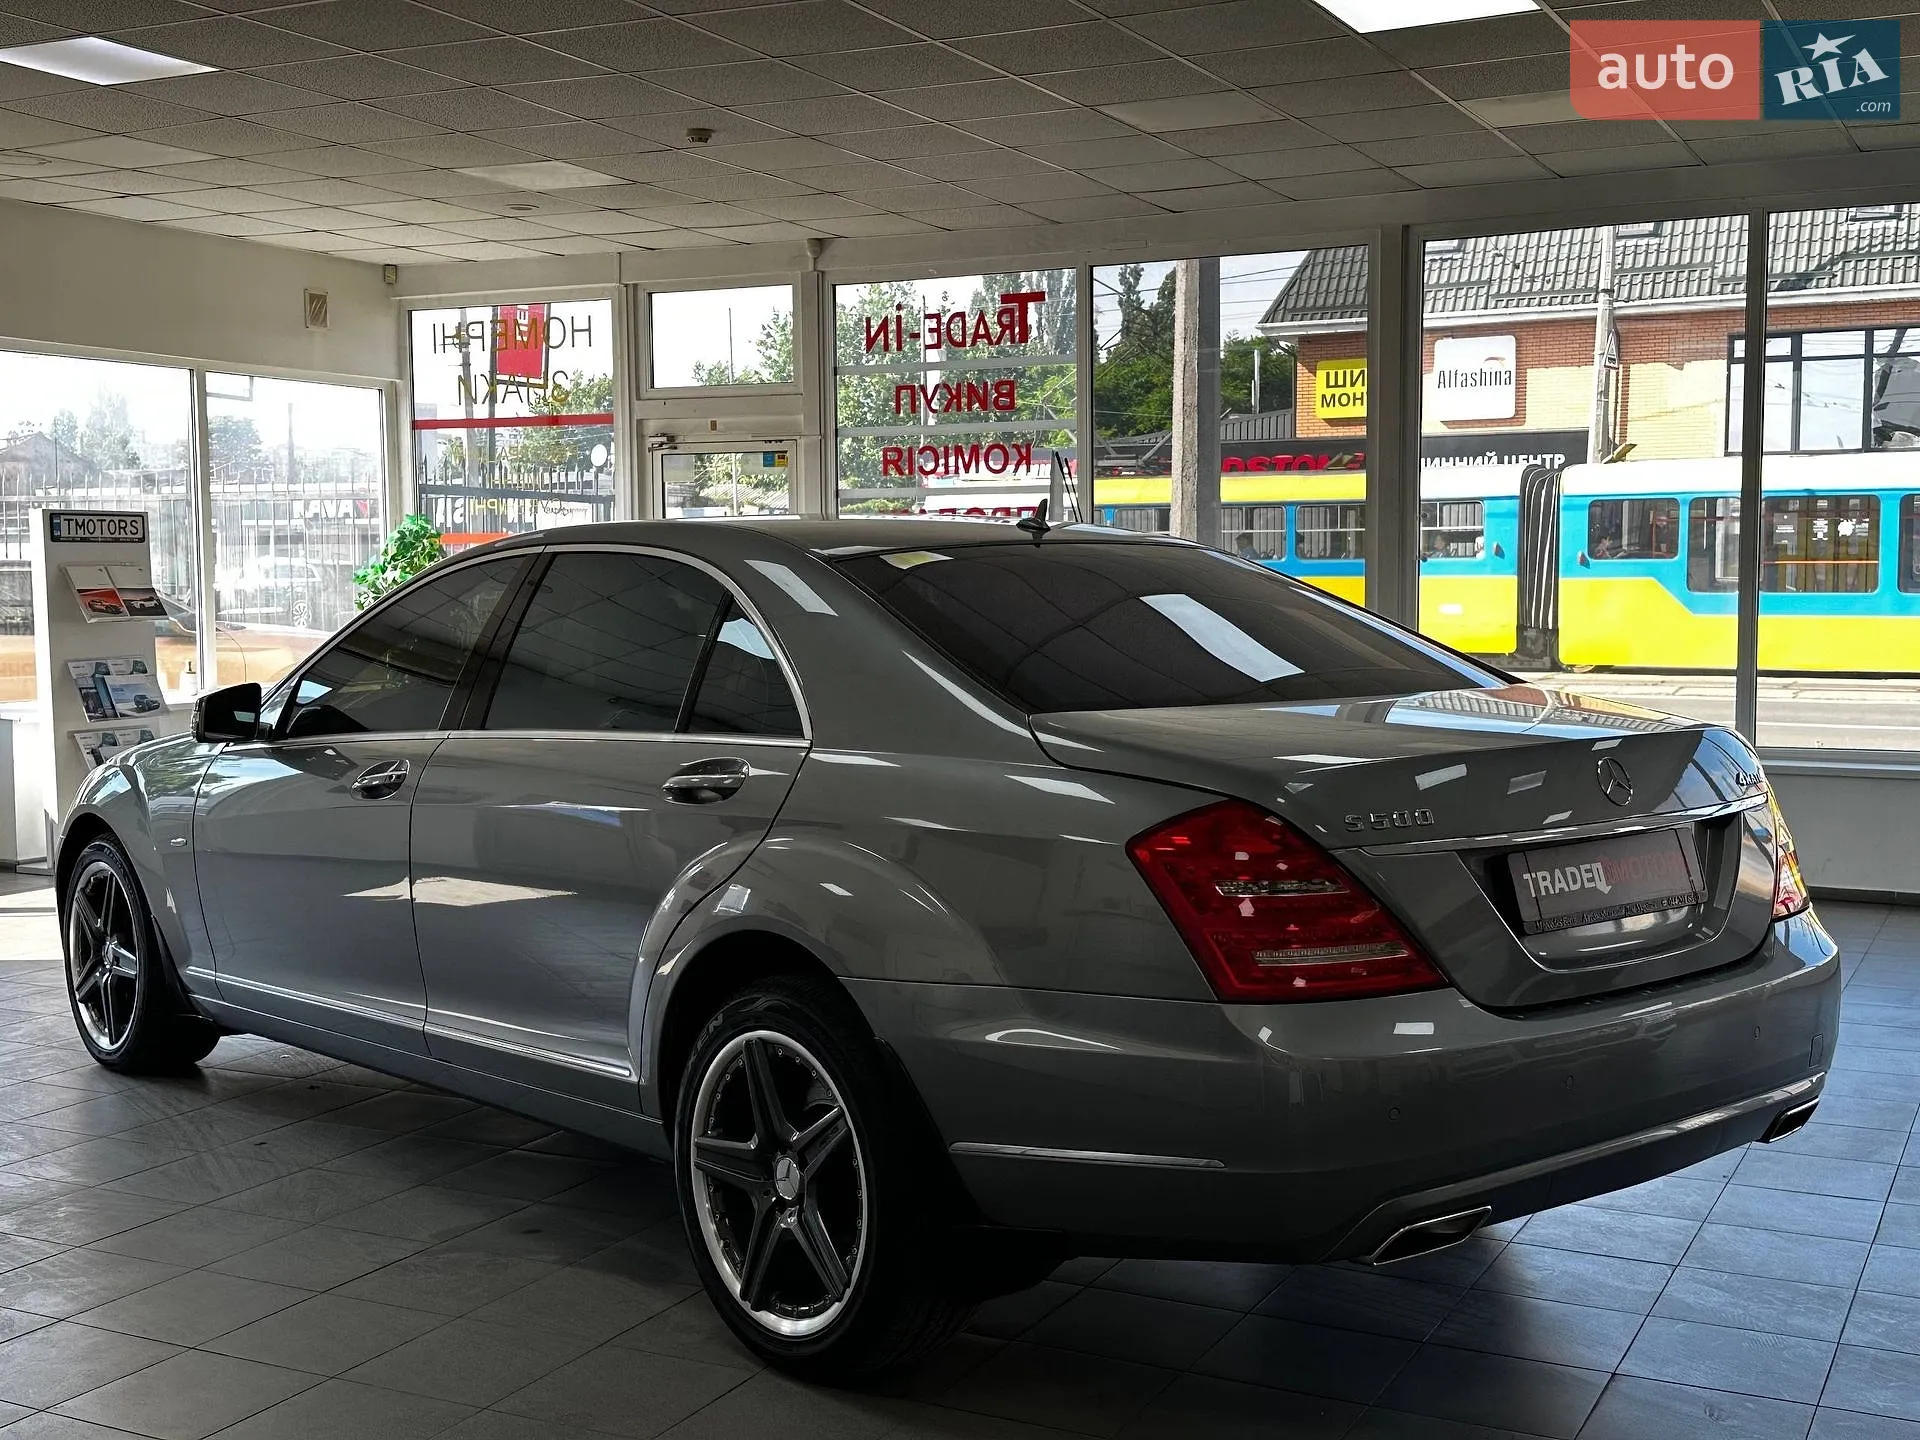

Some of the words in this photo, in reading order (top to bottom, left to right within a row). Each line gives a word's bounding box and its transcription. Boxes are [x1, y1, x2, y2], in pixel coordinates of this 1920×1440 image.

[1437, 366, 1513, 390] Alfashina
[1321, 391, 1368, 409] МОН
[63, 517, 140, 537] TMOTORS
[1344, 813, 1363, 833] S
[1366, 807, 1435, 830] 500
[1522, 862, 1597, 899] TRADE
